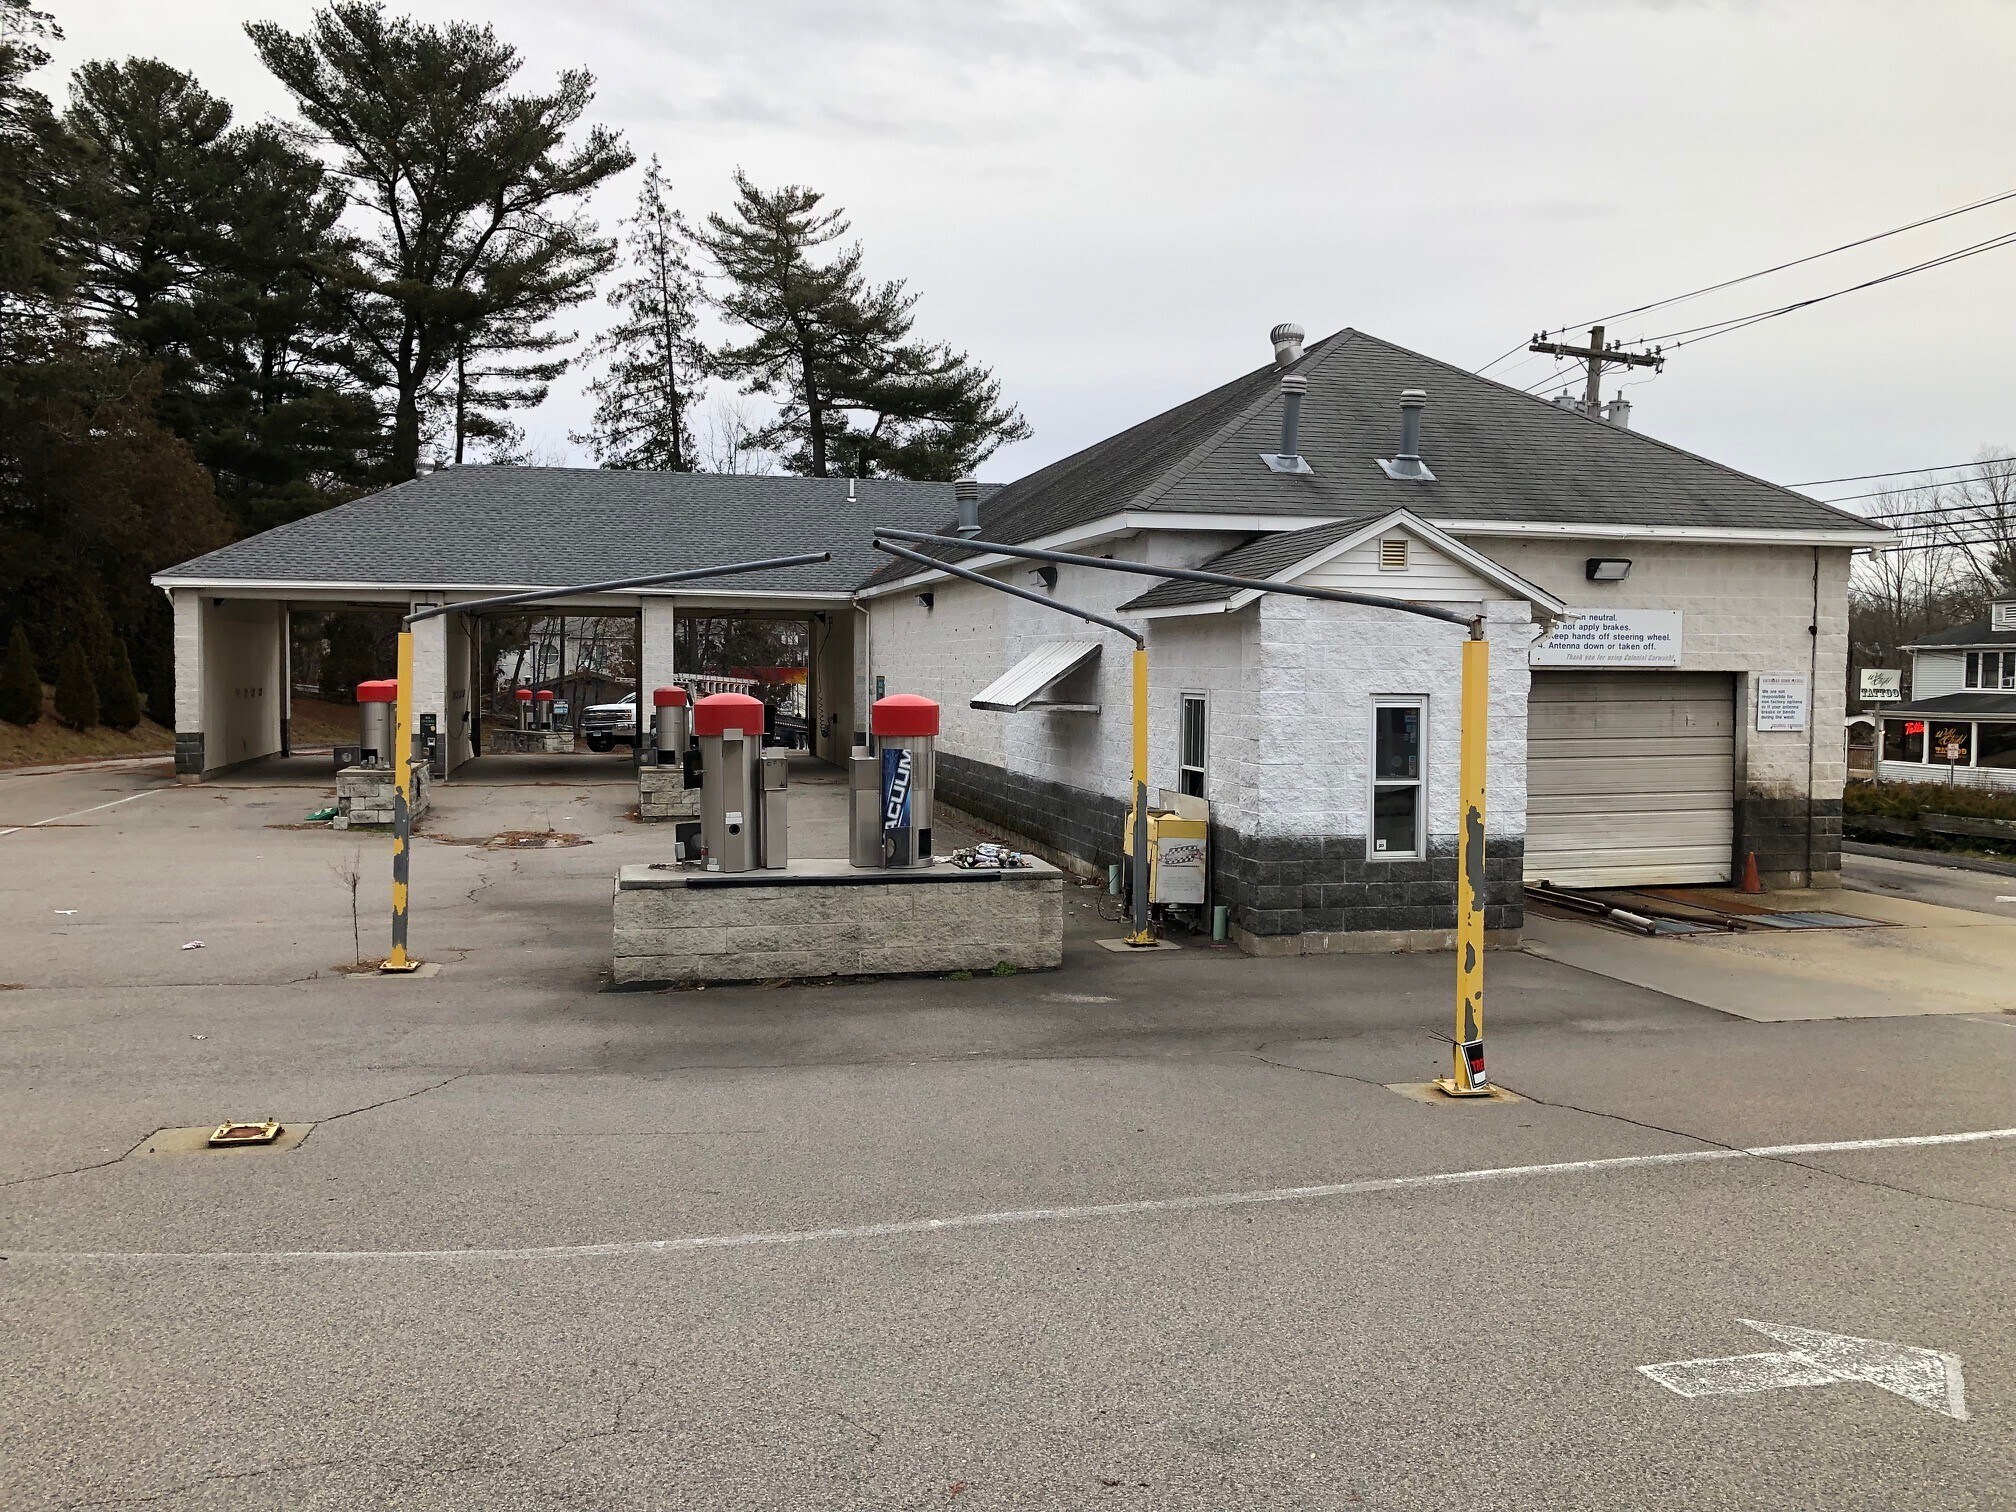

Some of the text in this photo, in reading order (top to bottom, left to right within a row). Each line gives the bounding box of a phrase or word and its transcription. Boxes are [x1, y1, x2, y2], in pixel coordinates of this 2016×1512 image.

[1578, 624, 1600, 632] apply
[1602, 623, 1631, 631] brakes.
[1572, 633, 1596, 641] hands
[1613, 633, 1644, 642] steering
[1548, 641, 1580, 650] Antenna
[1583, 642, 1605, 650] down
[1861, 688, 1900, 698] TATTOO
